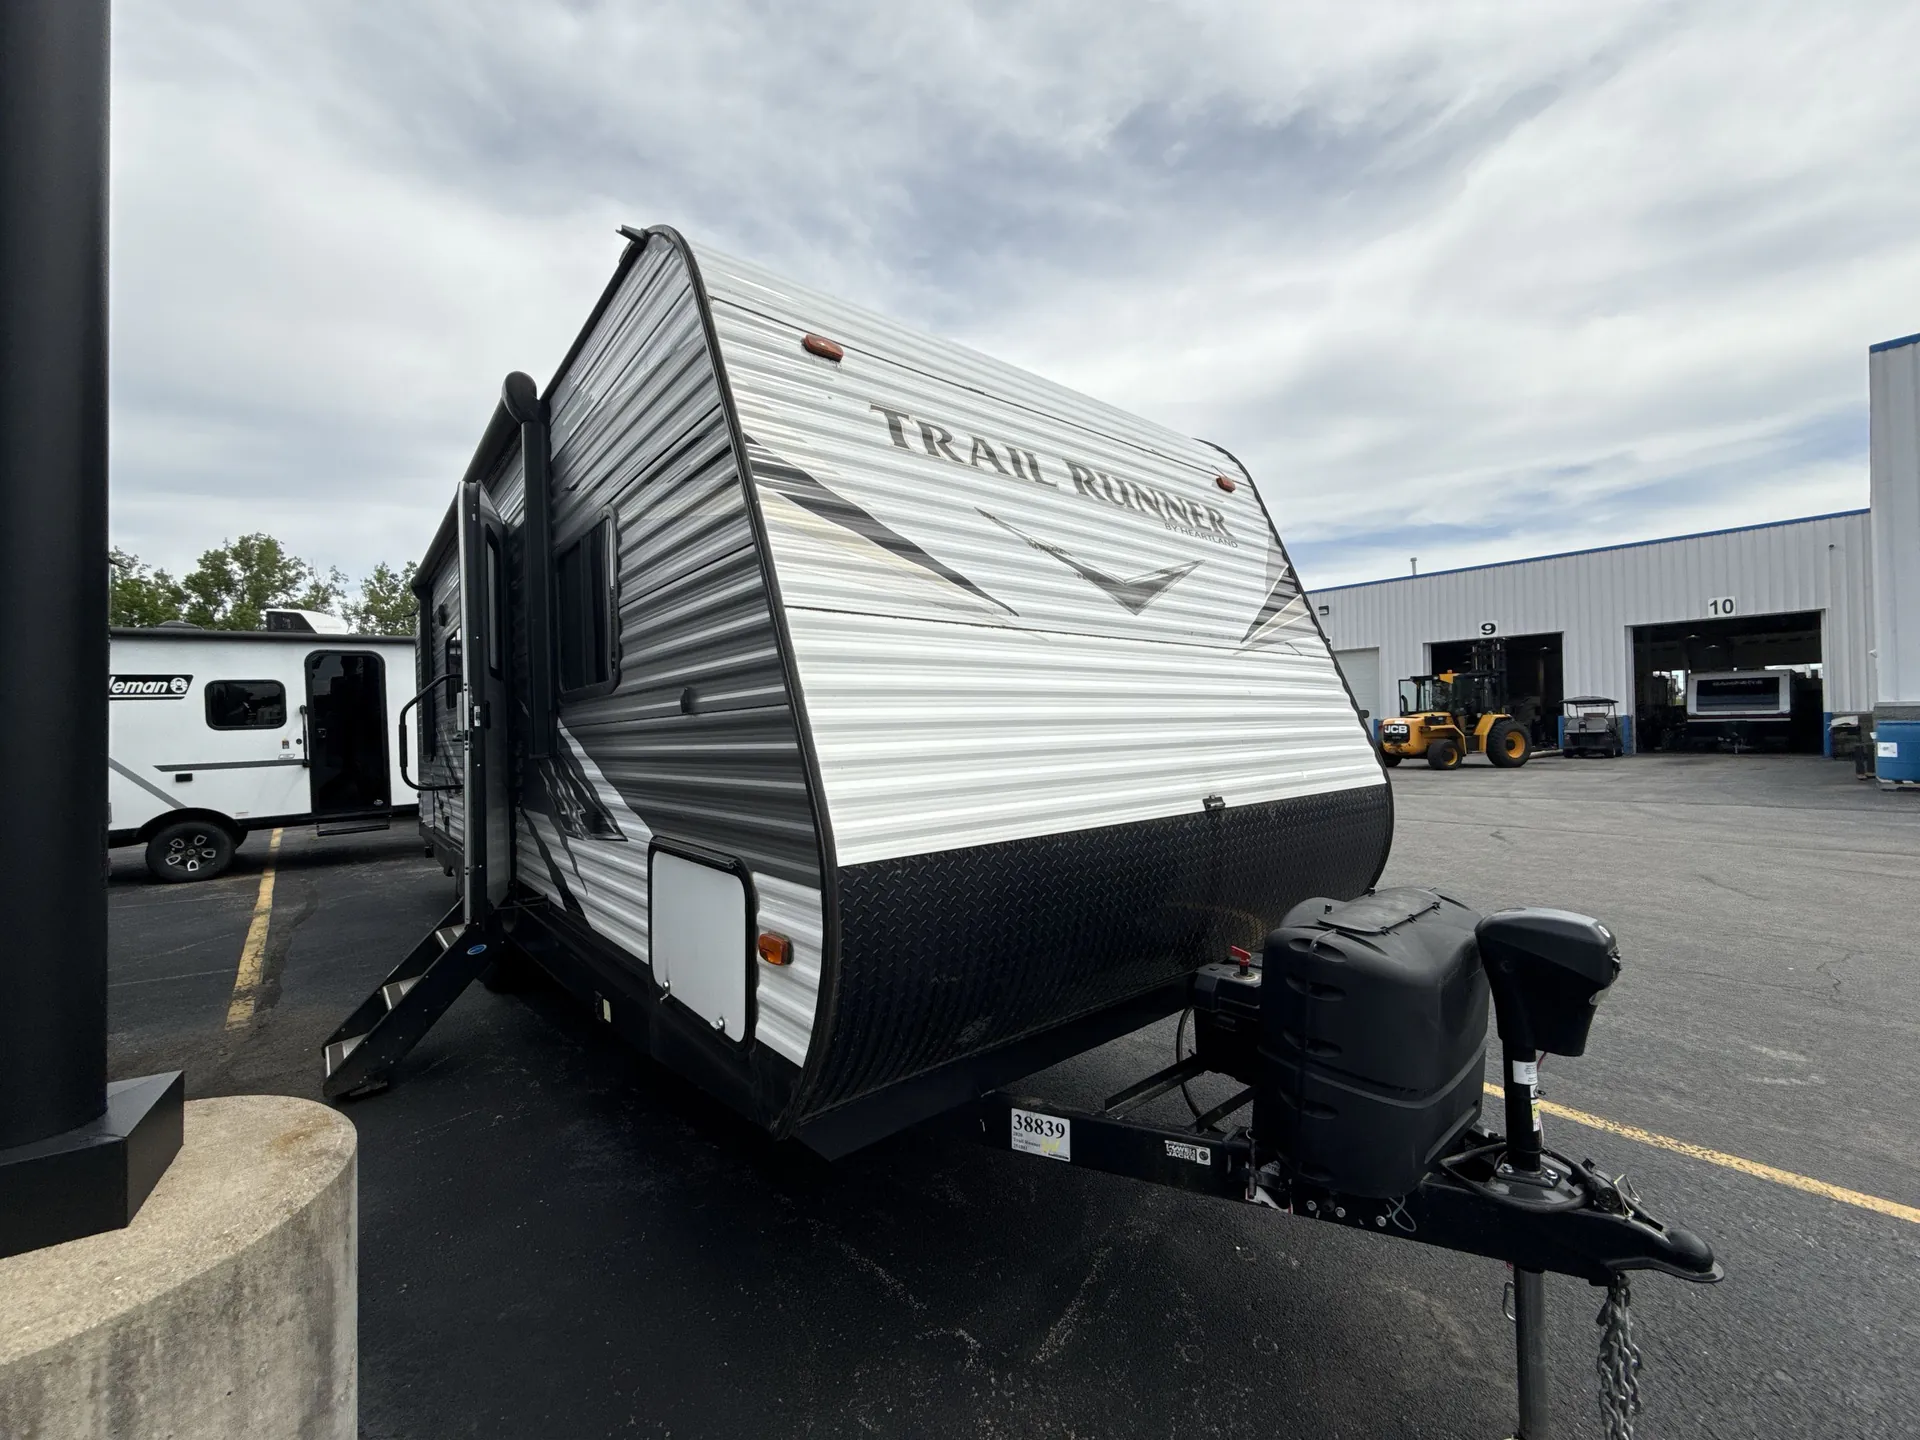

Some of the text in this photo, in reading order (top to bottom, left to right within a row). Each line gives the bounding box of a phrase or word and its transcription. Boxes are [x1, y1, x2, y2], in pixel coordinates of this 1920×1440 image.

[869, 403, 1236, 539] TRAIL RUNNER
[1165, 523, 1238, 549] BY HEARTLAND
[1709, 599, 1734, 615] 10
[1481, 623, 1496, 636] 9
[109, 676, 168, 694] leman
[1384, 725, 1408, 734] JCB
[1013, 1114, 1066, 1139] 38839
